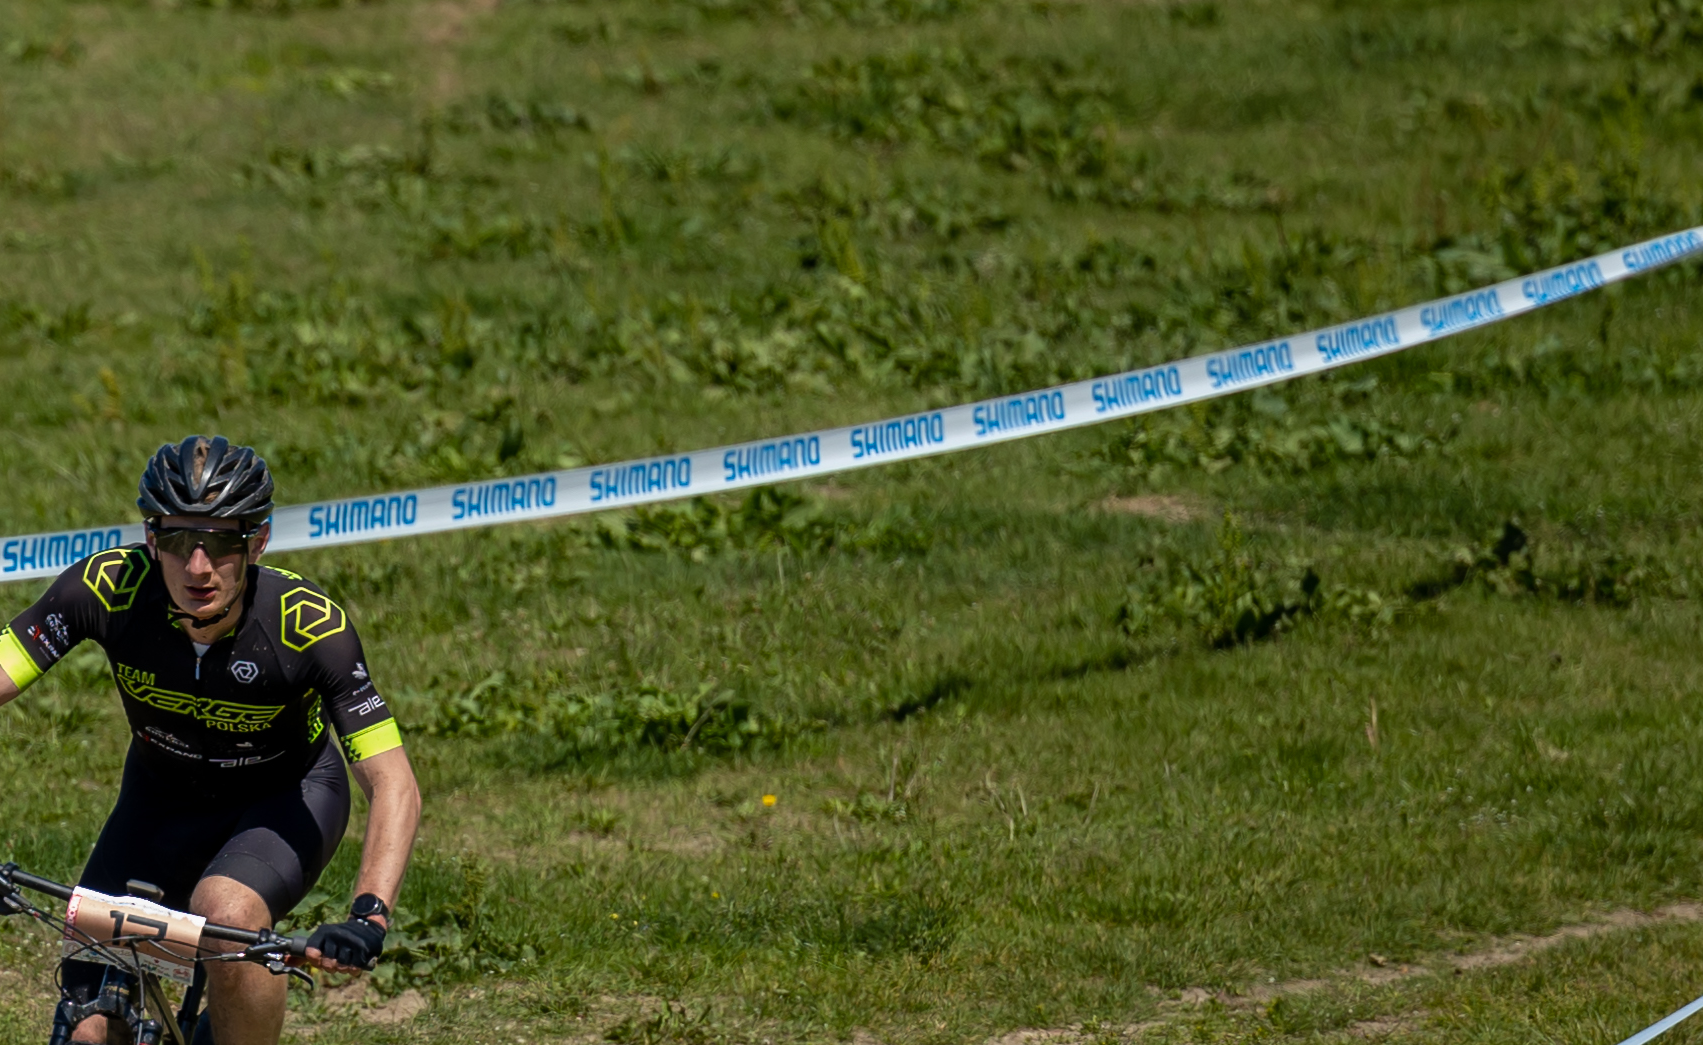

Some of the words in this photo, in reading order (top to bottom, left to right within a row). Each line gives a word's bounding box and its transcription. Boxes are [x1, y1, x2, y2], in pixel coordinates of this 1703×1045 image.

[1421, 290, 1504, 337] SHIMANO
[1316, 318, 1399, 363] SHIMANO
[1207, 342, 1293, 388] SHIMANO
[1092, 367, 1182, 413] SHIMANO
[850, 413, 944, 459] SHIMANO
[973, 391, 1065, 436] SHIMANO
[590, 457, 691, 502] SHIMANO
[723, 436, 820, 482] SHIMANO
[309, 494, 418, 538] SHIMANO
[452, 477, 556, 520] SHIMANO
[3, 529, 122, 573] SHIMANO
[117, 663, 155, 685] TEAM
[117, 674, 286, 724] VERGE
[206, 719, 272, 732] POLSKA
[110, 910, 168, 945] 17
